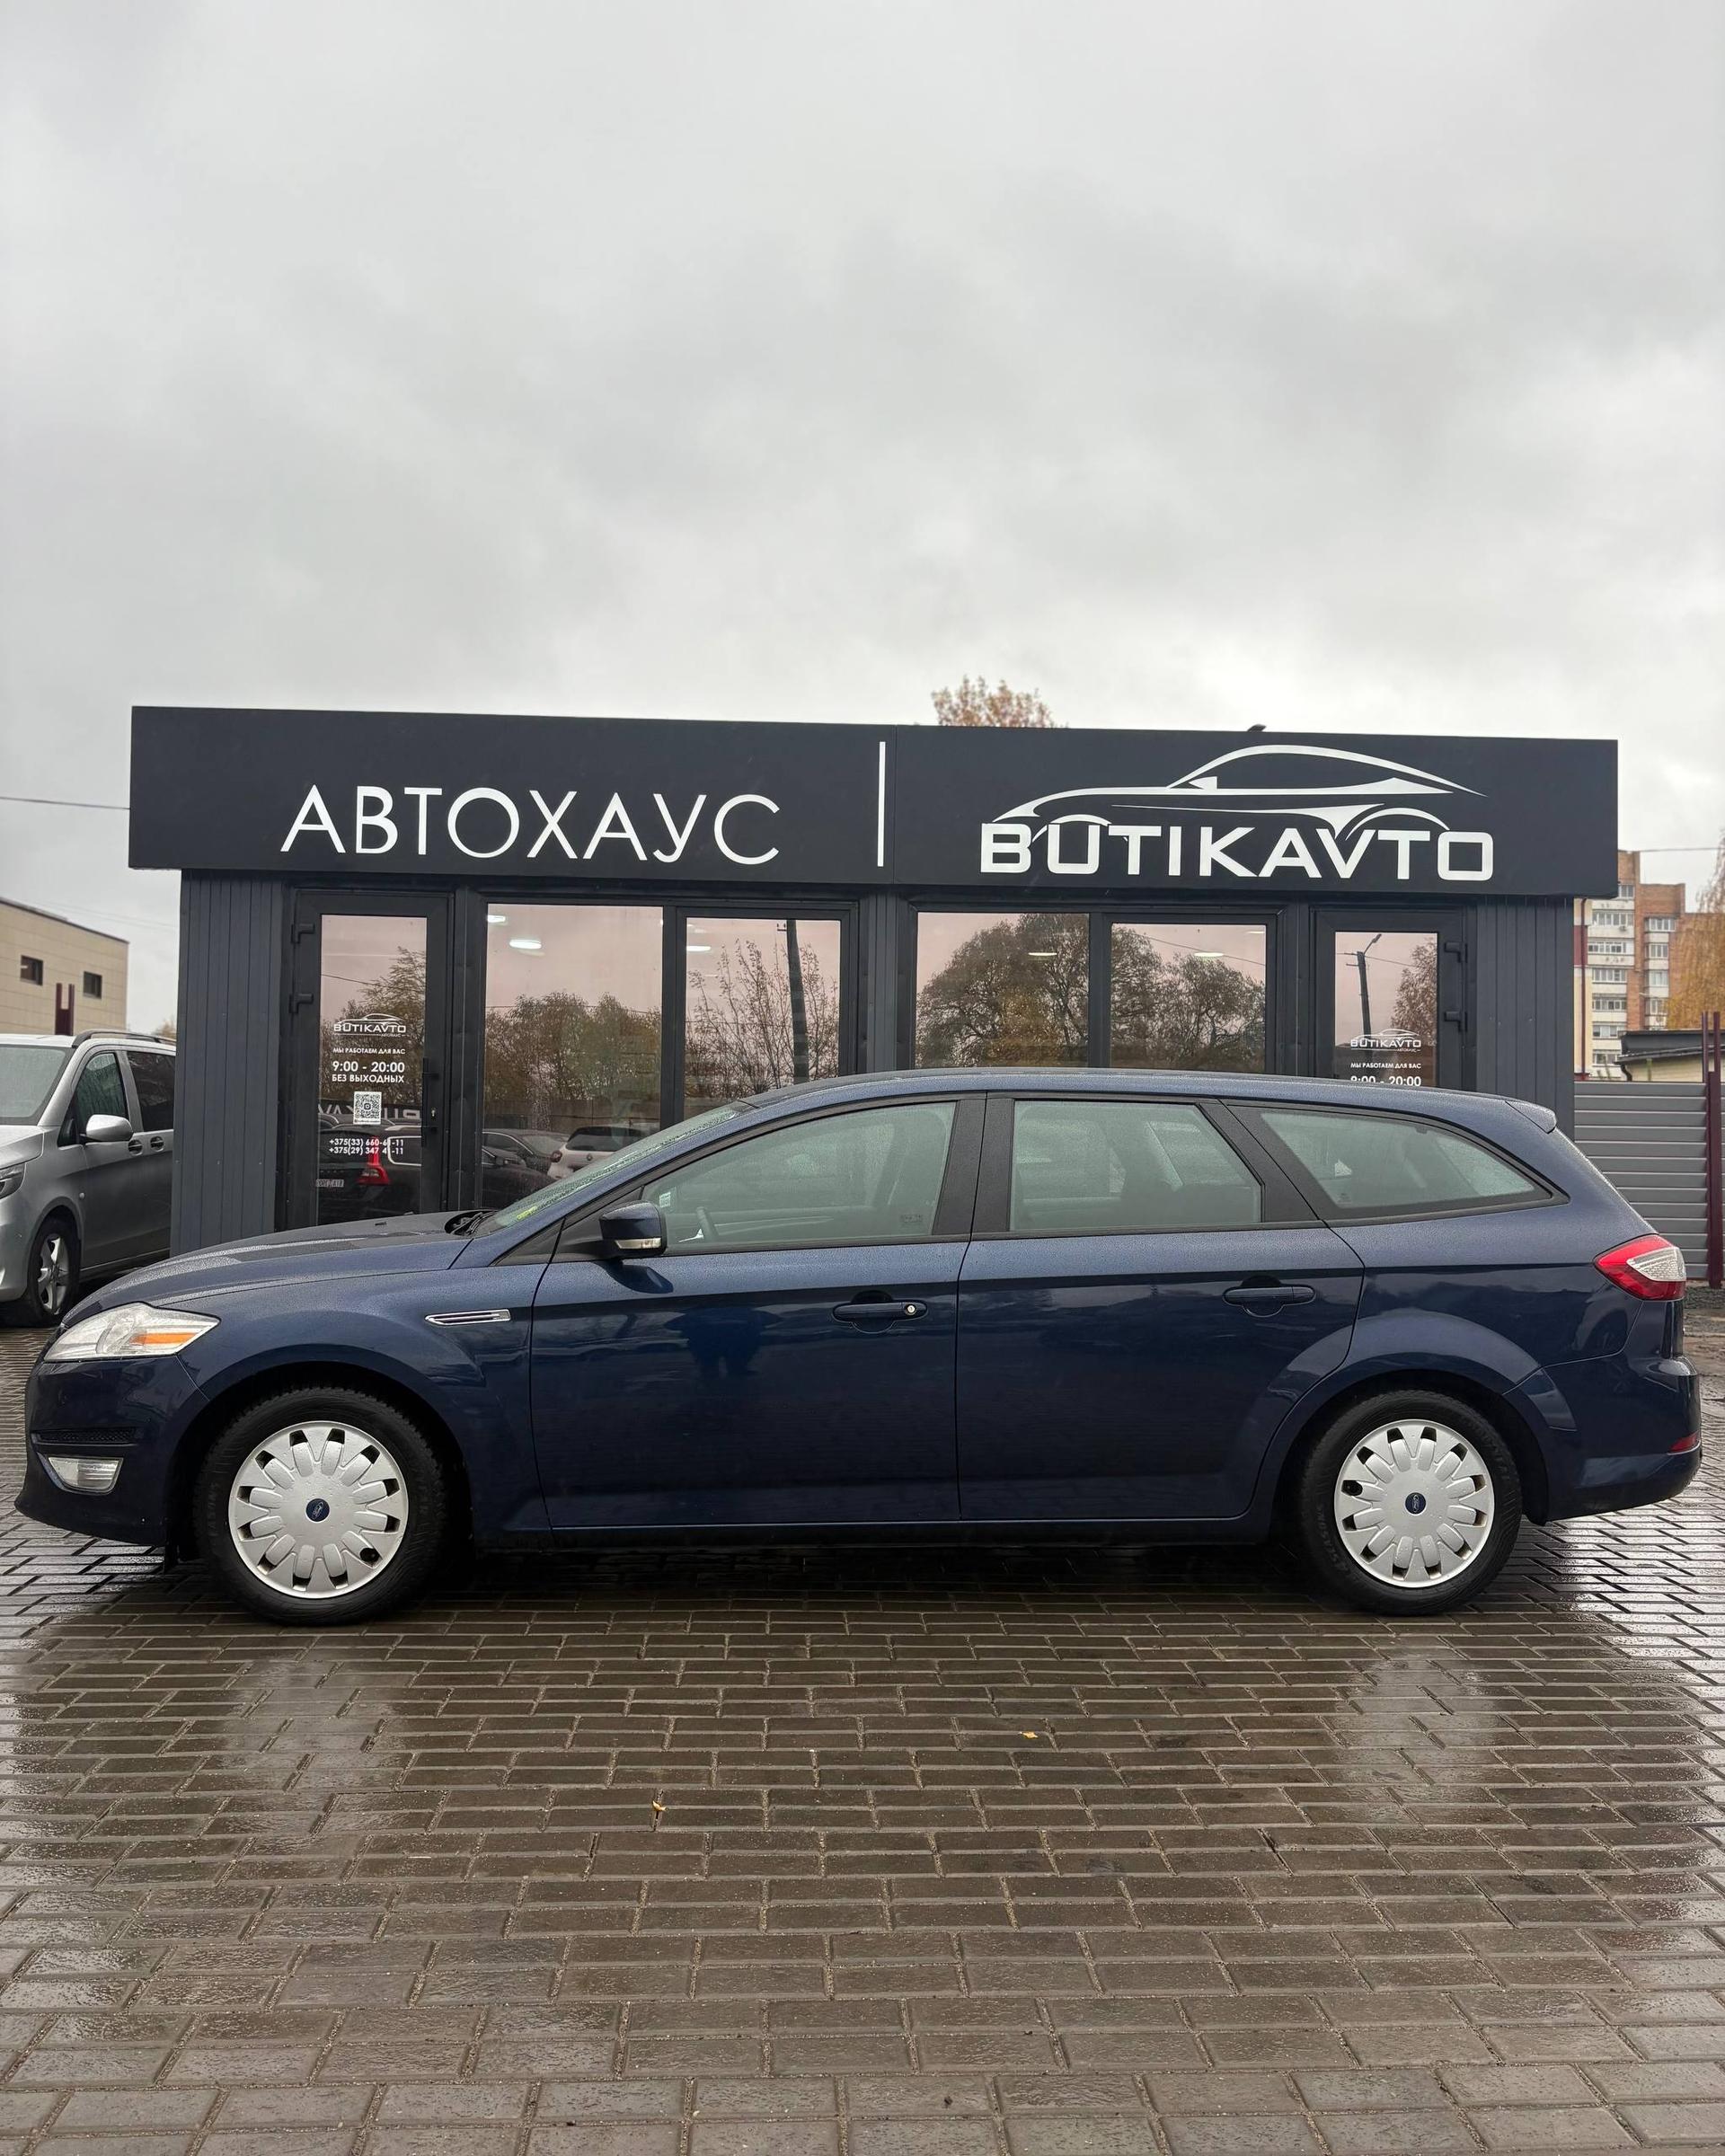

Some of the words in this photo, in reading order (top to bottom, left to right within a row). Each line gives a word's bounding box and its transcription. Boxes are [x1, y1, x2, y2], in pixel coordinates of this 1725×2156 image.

[280, 784, 781, 865] АВТОХАУС
[980, 822, 1494, 881] BUTIKAVTO
[333, 1023, 407, 1033] BUTIKAVTO
[1350, 1038, 1422, 1048] BUTIKAVTO
[332, 1061, 358, 1072] 9:00
[371, 1062, 405, 1073] 20:00
[349, 1074, 404, 1083] ВЫХОДНЫХ
[1389, 1076, 1422, 1087] 20:00
[329, 1138, 364, 1147] +375(33)
[365, 1139, 404, 1147] 660-6-11
[329, 1146, 364, 1155] +375(29)
